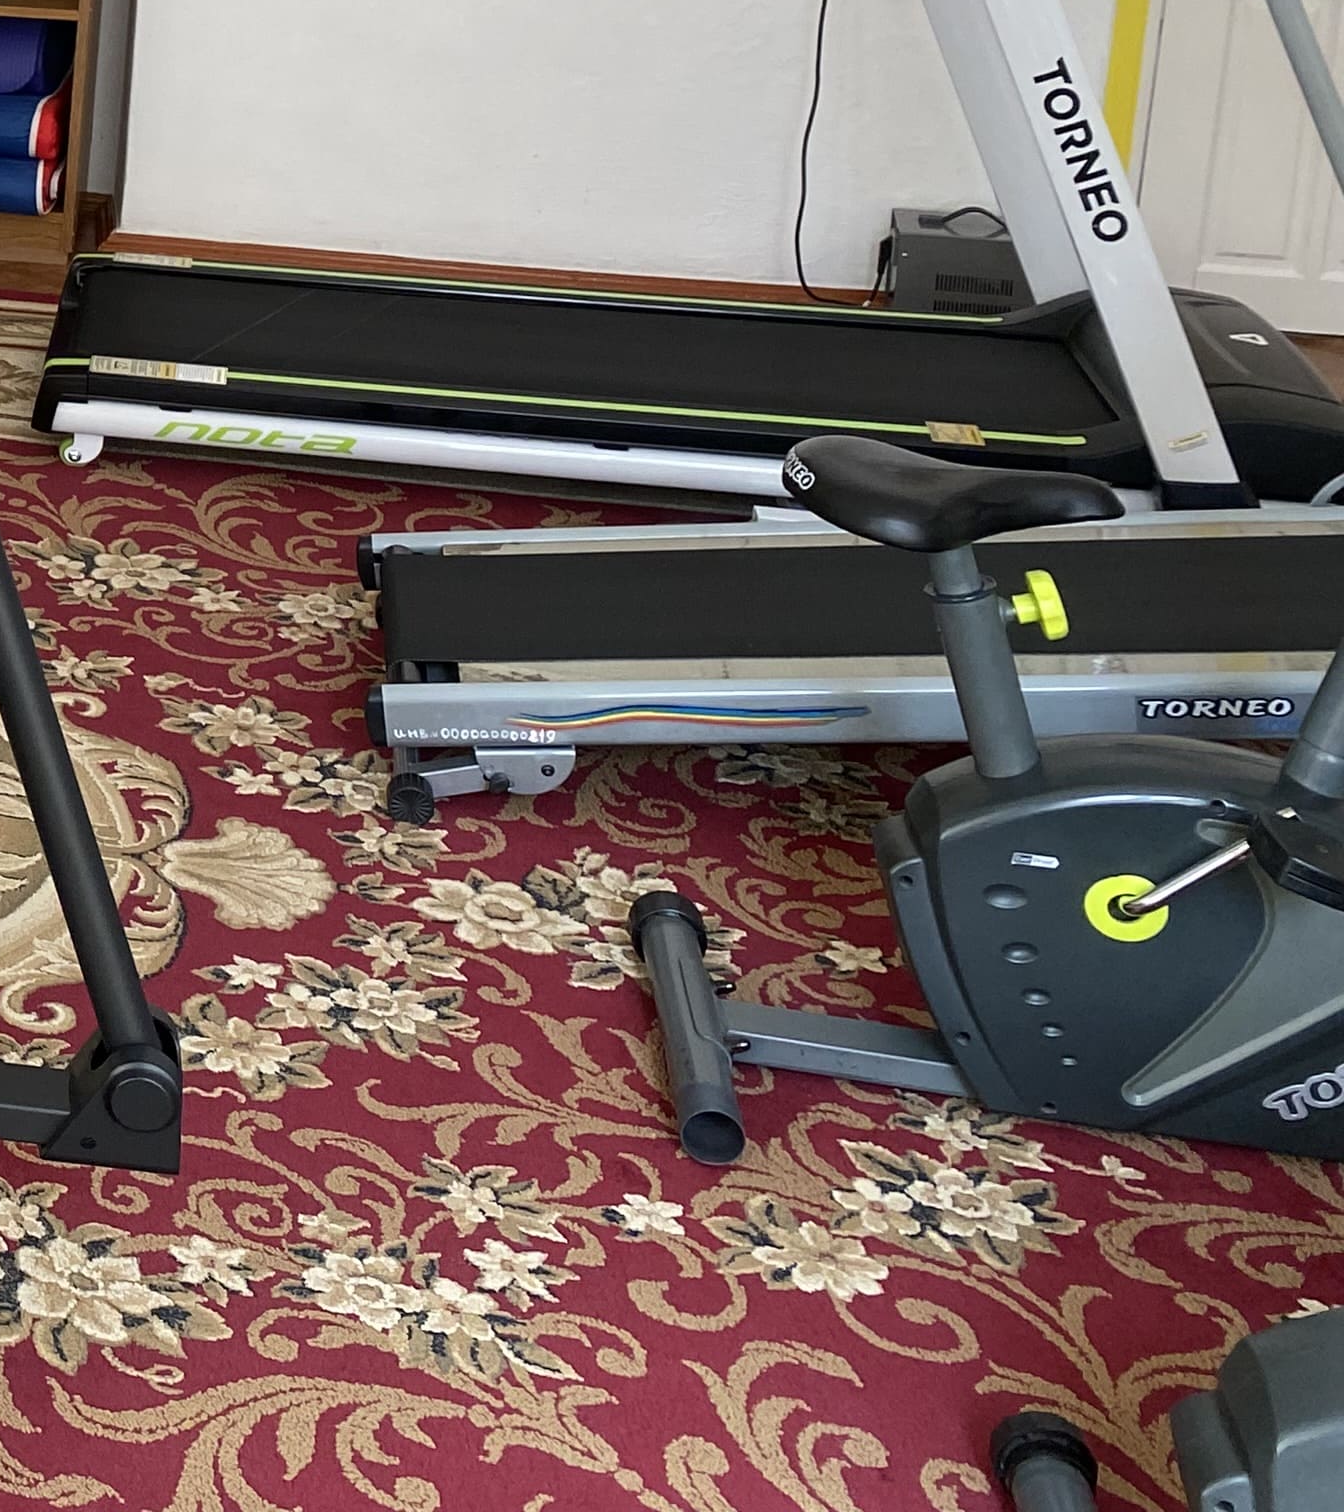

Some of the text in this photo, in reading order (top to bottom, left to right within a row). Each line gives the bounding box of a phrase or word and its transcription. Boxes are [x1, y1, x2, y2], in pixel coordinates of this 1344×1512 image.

[1033, 56, 1129, 242] TORNEO
[1140, 697, 1294, 719] TORNEO
[1262, 1065, 1344, 1120] TO
